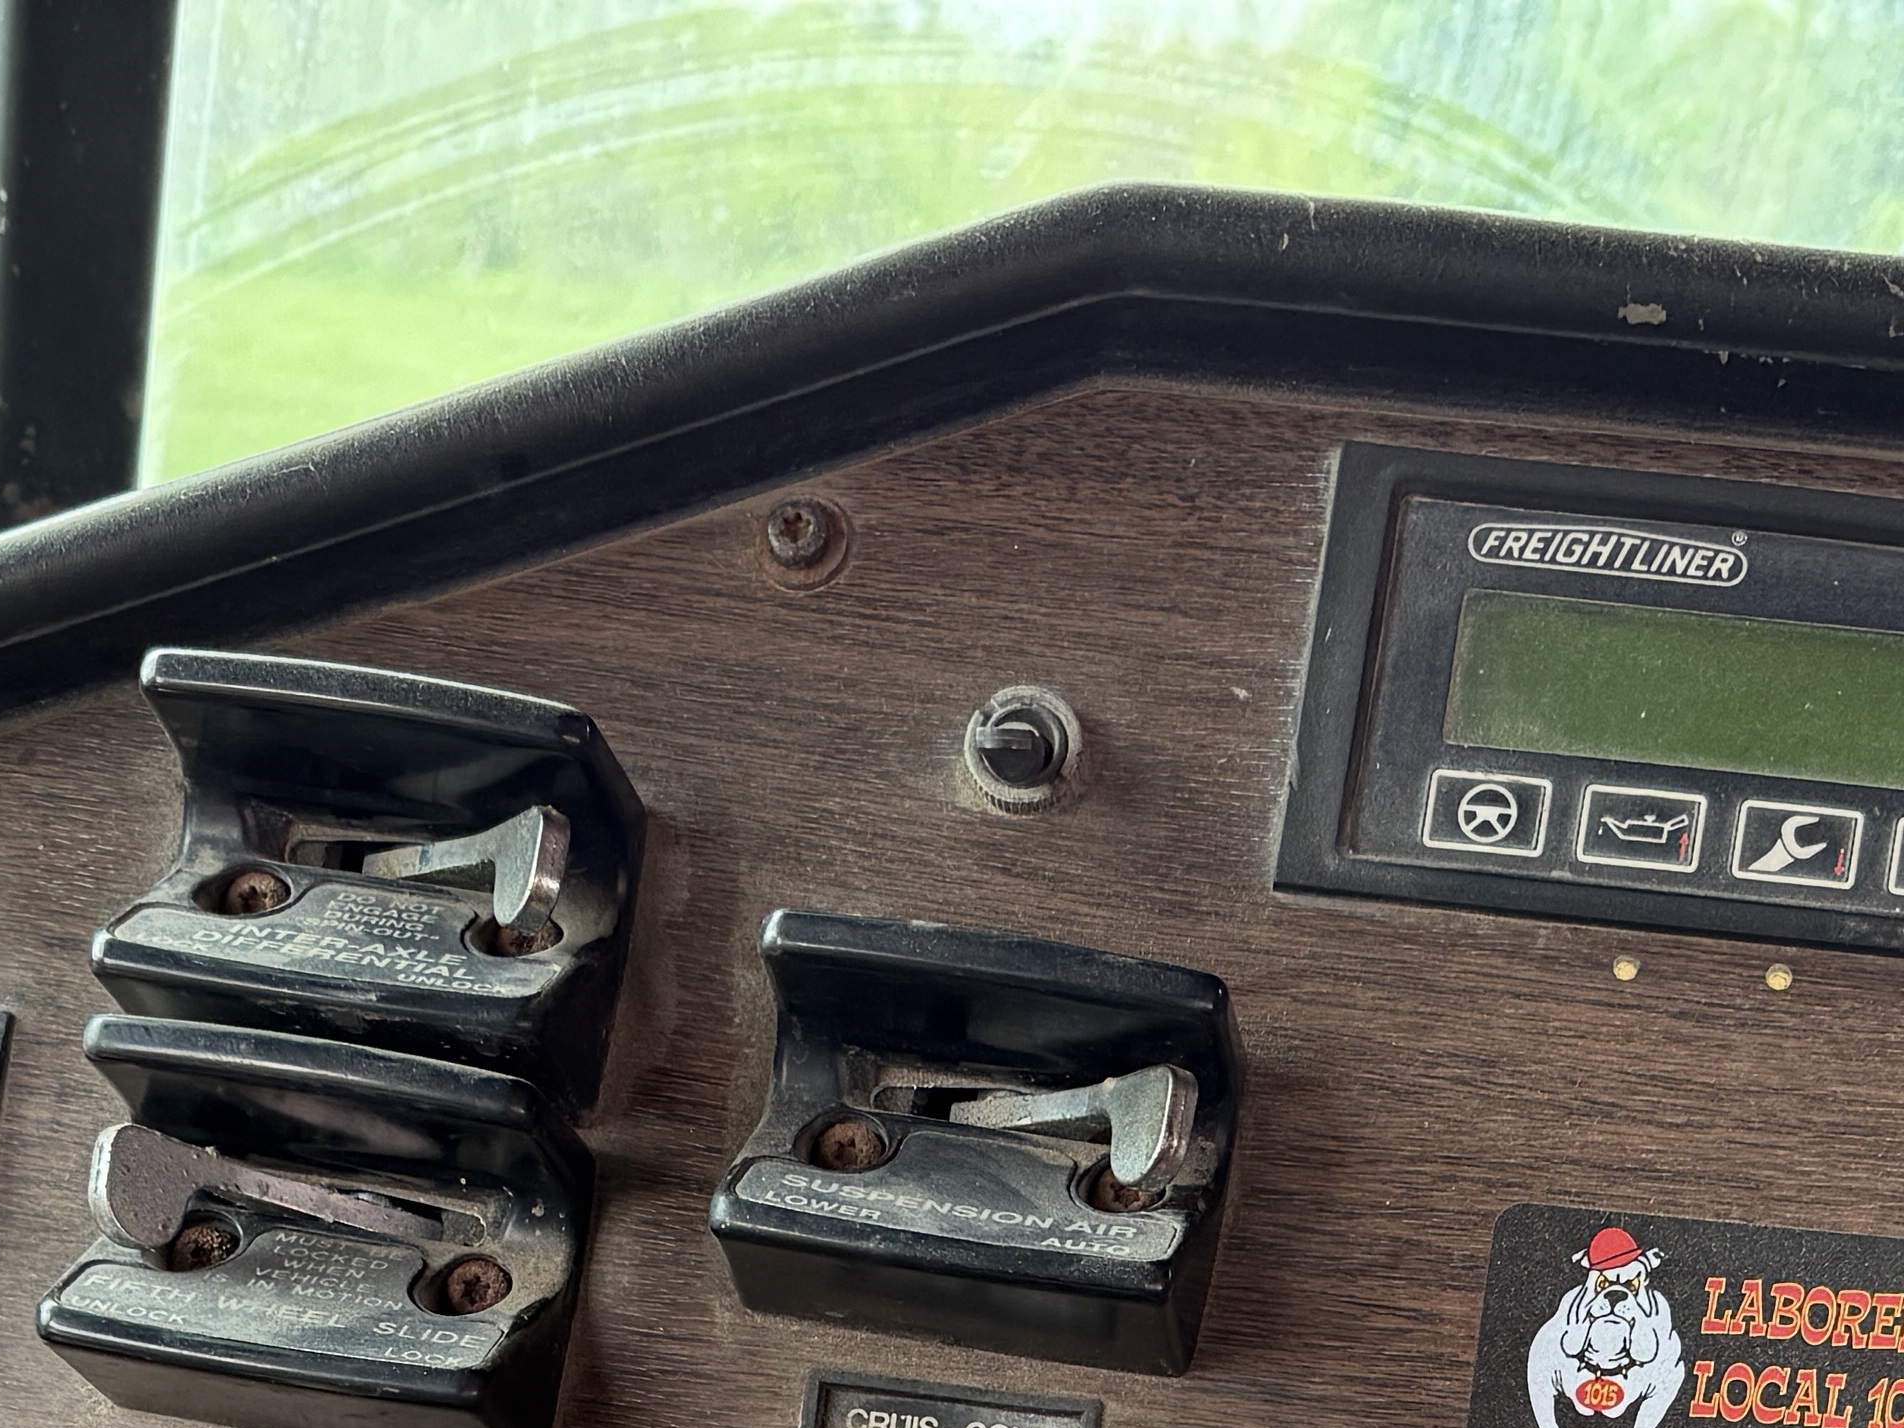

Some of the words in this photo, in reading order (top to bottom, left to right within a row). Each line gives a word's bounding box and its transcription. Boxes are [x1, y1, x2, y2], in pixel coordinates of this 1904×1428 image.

[1480, 527, 1736, 580] FREIGHTLINER
[191, 930, 476, 981] DIFFERENTIAL
[226, 923, 468, 967] INTER-AXLE
[397, 972, 507, 995] UNLOCK
[765, 1189, 884, 1222] LOWER
[781, 1173, 1054, 1230] SUSPENSION
[1040, 1236, 1132, 1256] AUTO
[65, 1294, 190, 1326] UNLOCK
[84, 1272, 197, 1304] FIFTH
[216, 1298, 350, 1330] WHEEL
[373, 1320, 489, 1350] SLIDE
[383, 1346, 471, 1369] LOCK
[1582, 1381, 1620, 1407] 1015
